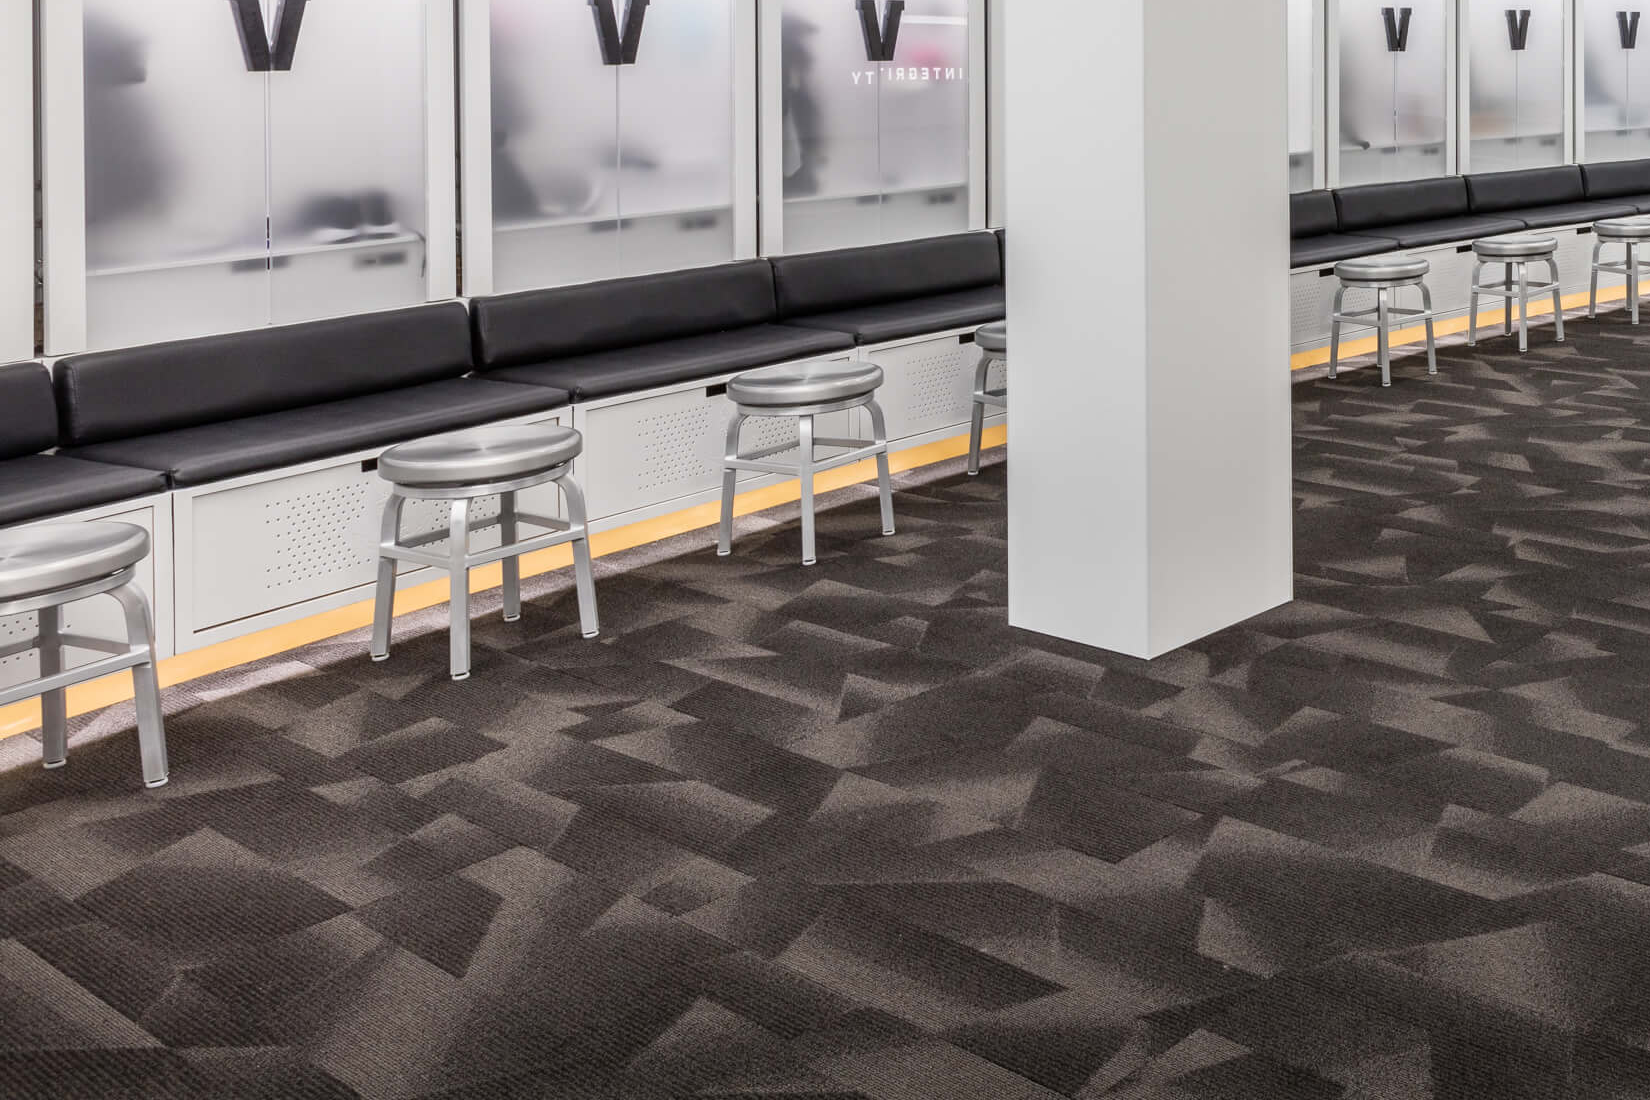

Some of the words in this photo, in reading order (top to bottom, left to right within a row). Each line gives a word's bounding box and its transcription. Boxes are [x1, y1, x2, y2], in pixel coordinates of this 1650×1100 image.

[855, 0, 904, 61] V
[1381, 7, 1412, 51] V
[1505, 9, 1531, 50] V
[1616, 11, 1640, 49] V
